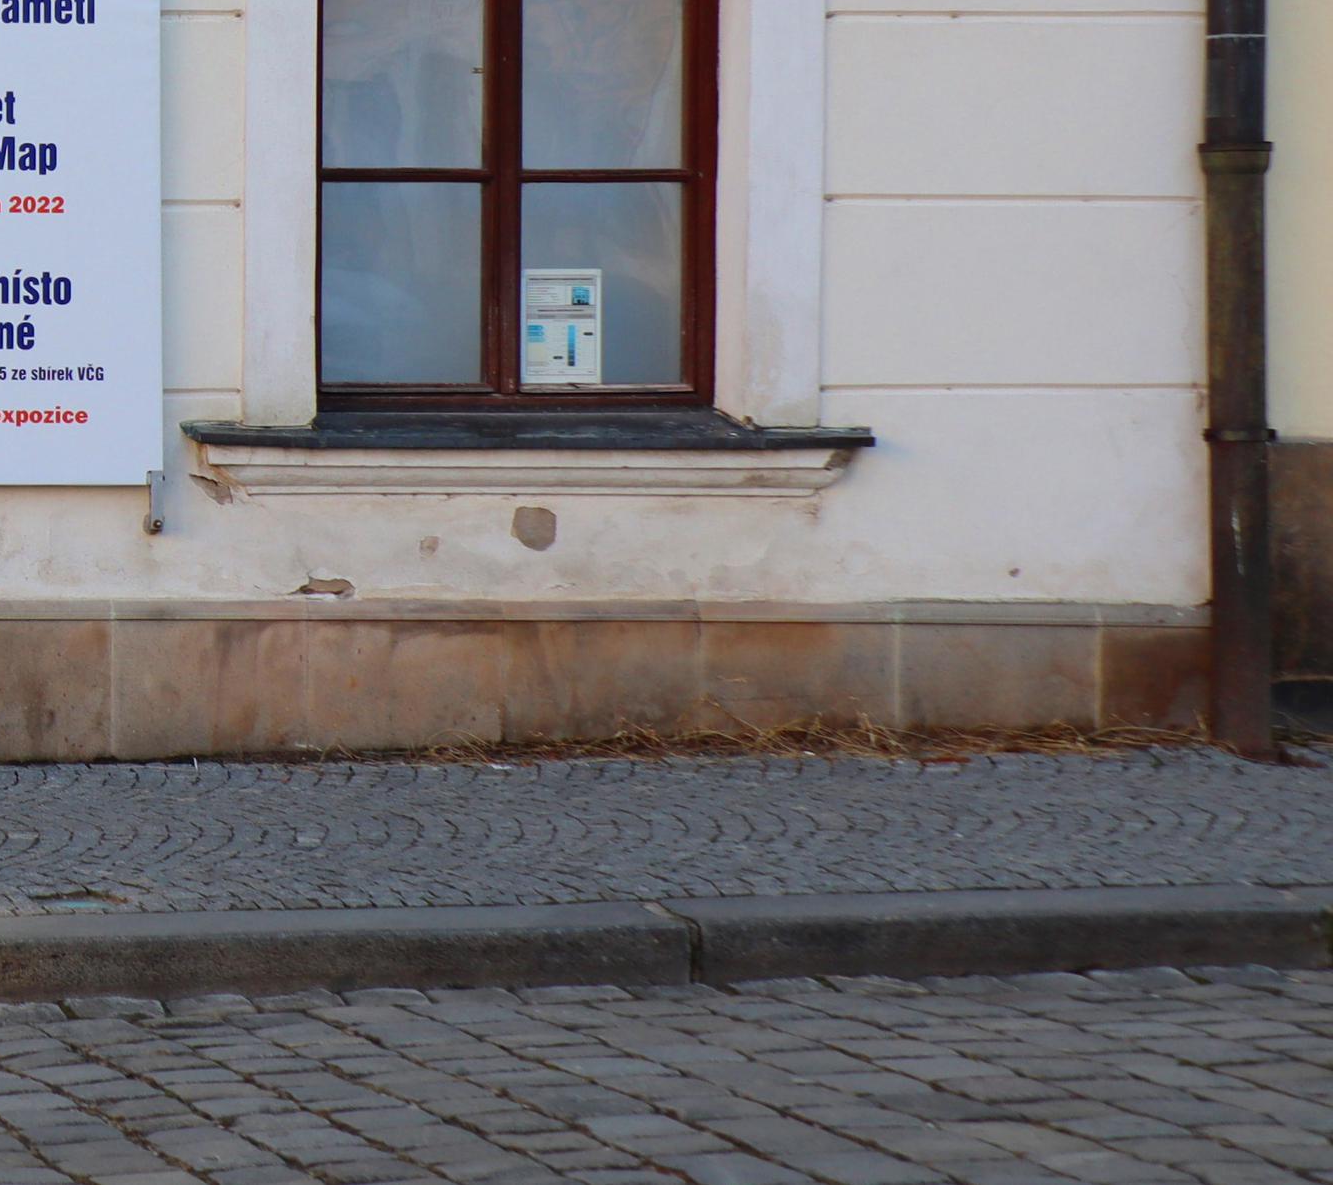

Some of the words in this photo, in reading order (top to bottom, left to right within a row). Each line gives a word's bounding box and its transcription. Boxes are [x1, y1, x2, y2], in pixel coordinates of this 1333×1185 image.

[9, 196, 65, 214] 2022
[11, 369, 27, 380] ze
[31, 365, 73, 381] sbírek
[78, 363, 104, 381] VČG
